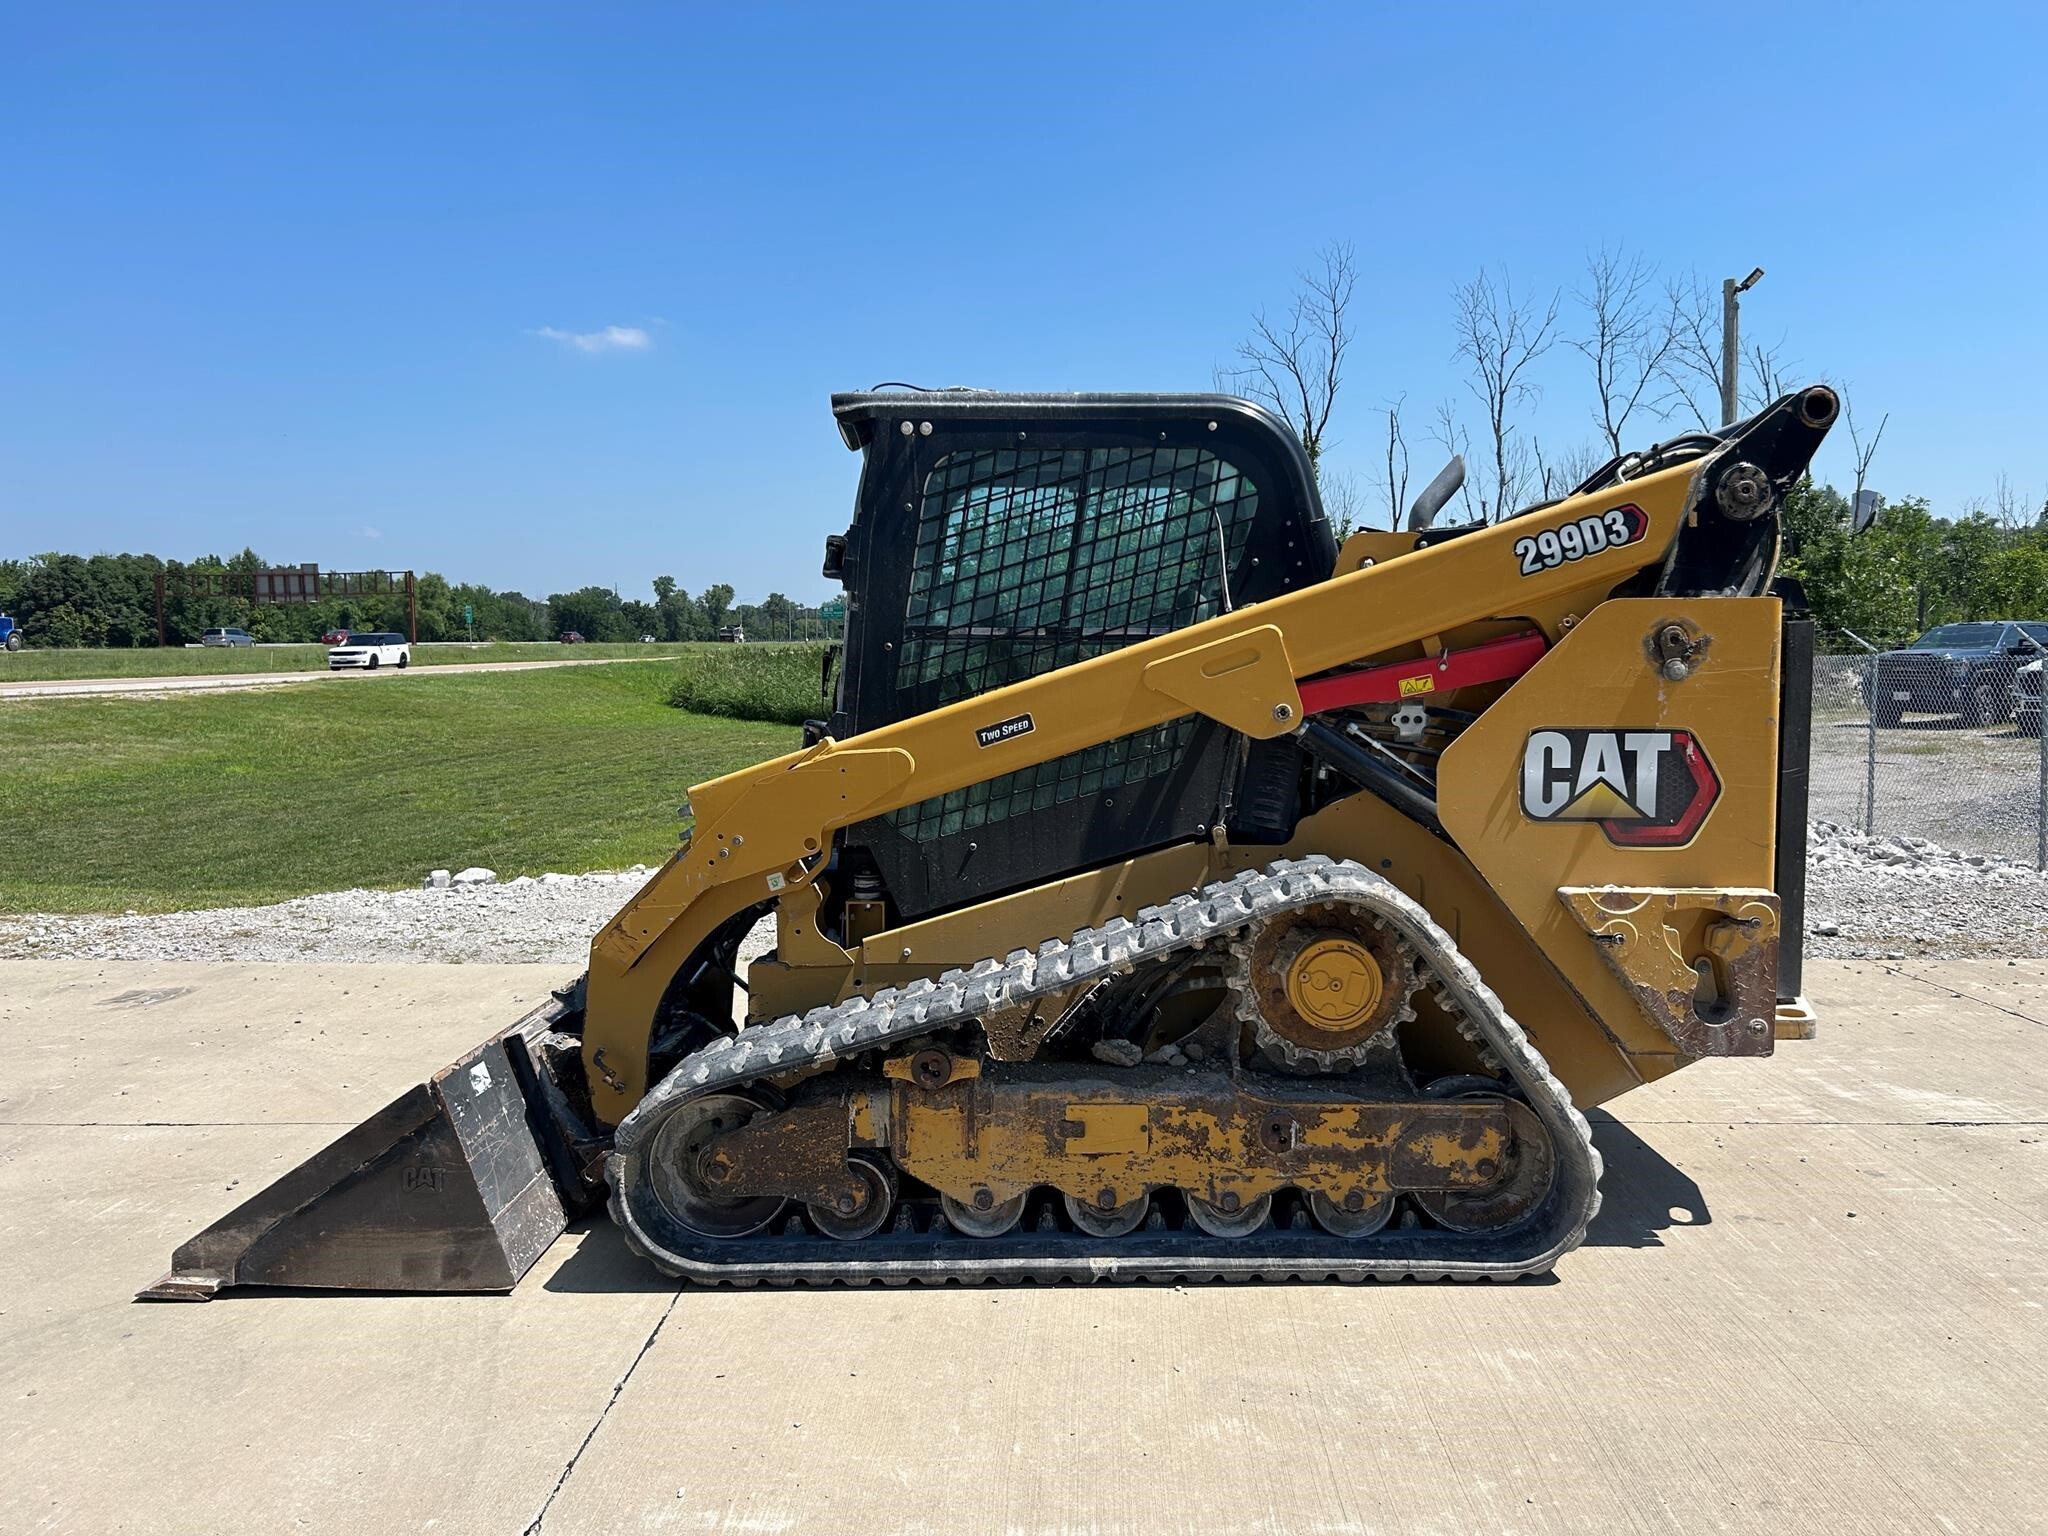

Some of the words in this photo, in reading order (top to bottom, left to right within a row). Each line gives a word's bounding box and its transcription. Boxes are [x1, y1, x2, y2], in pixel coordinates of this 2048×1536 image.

[1515, 510, 1630, 575] 299D3
[1524, 731, 1671, 818] CAT
[402, 1167, 446, 1193] CAT
